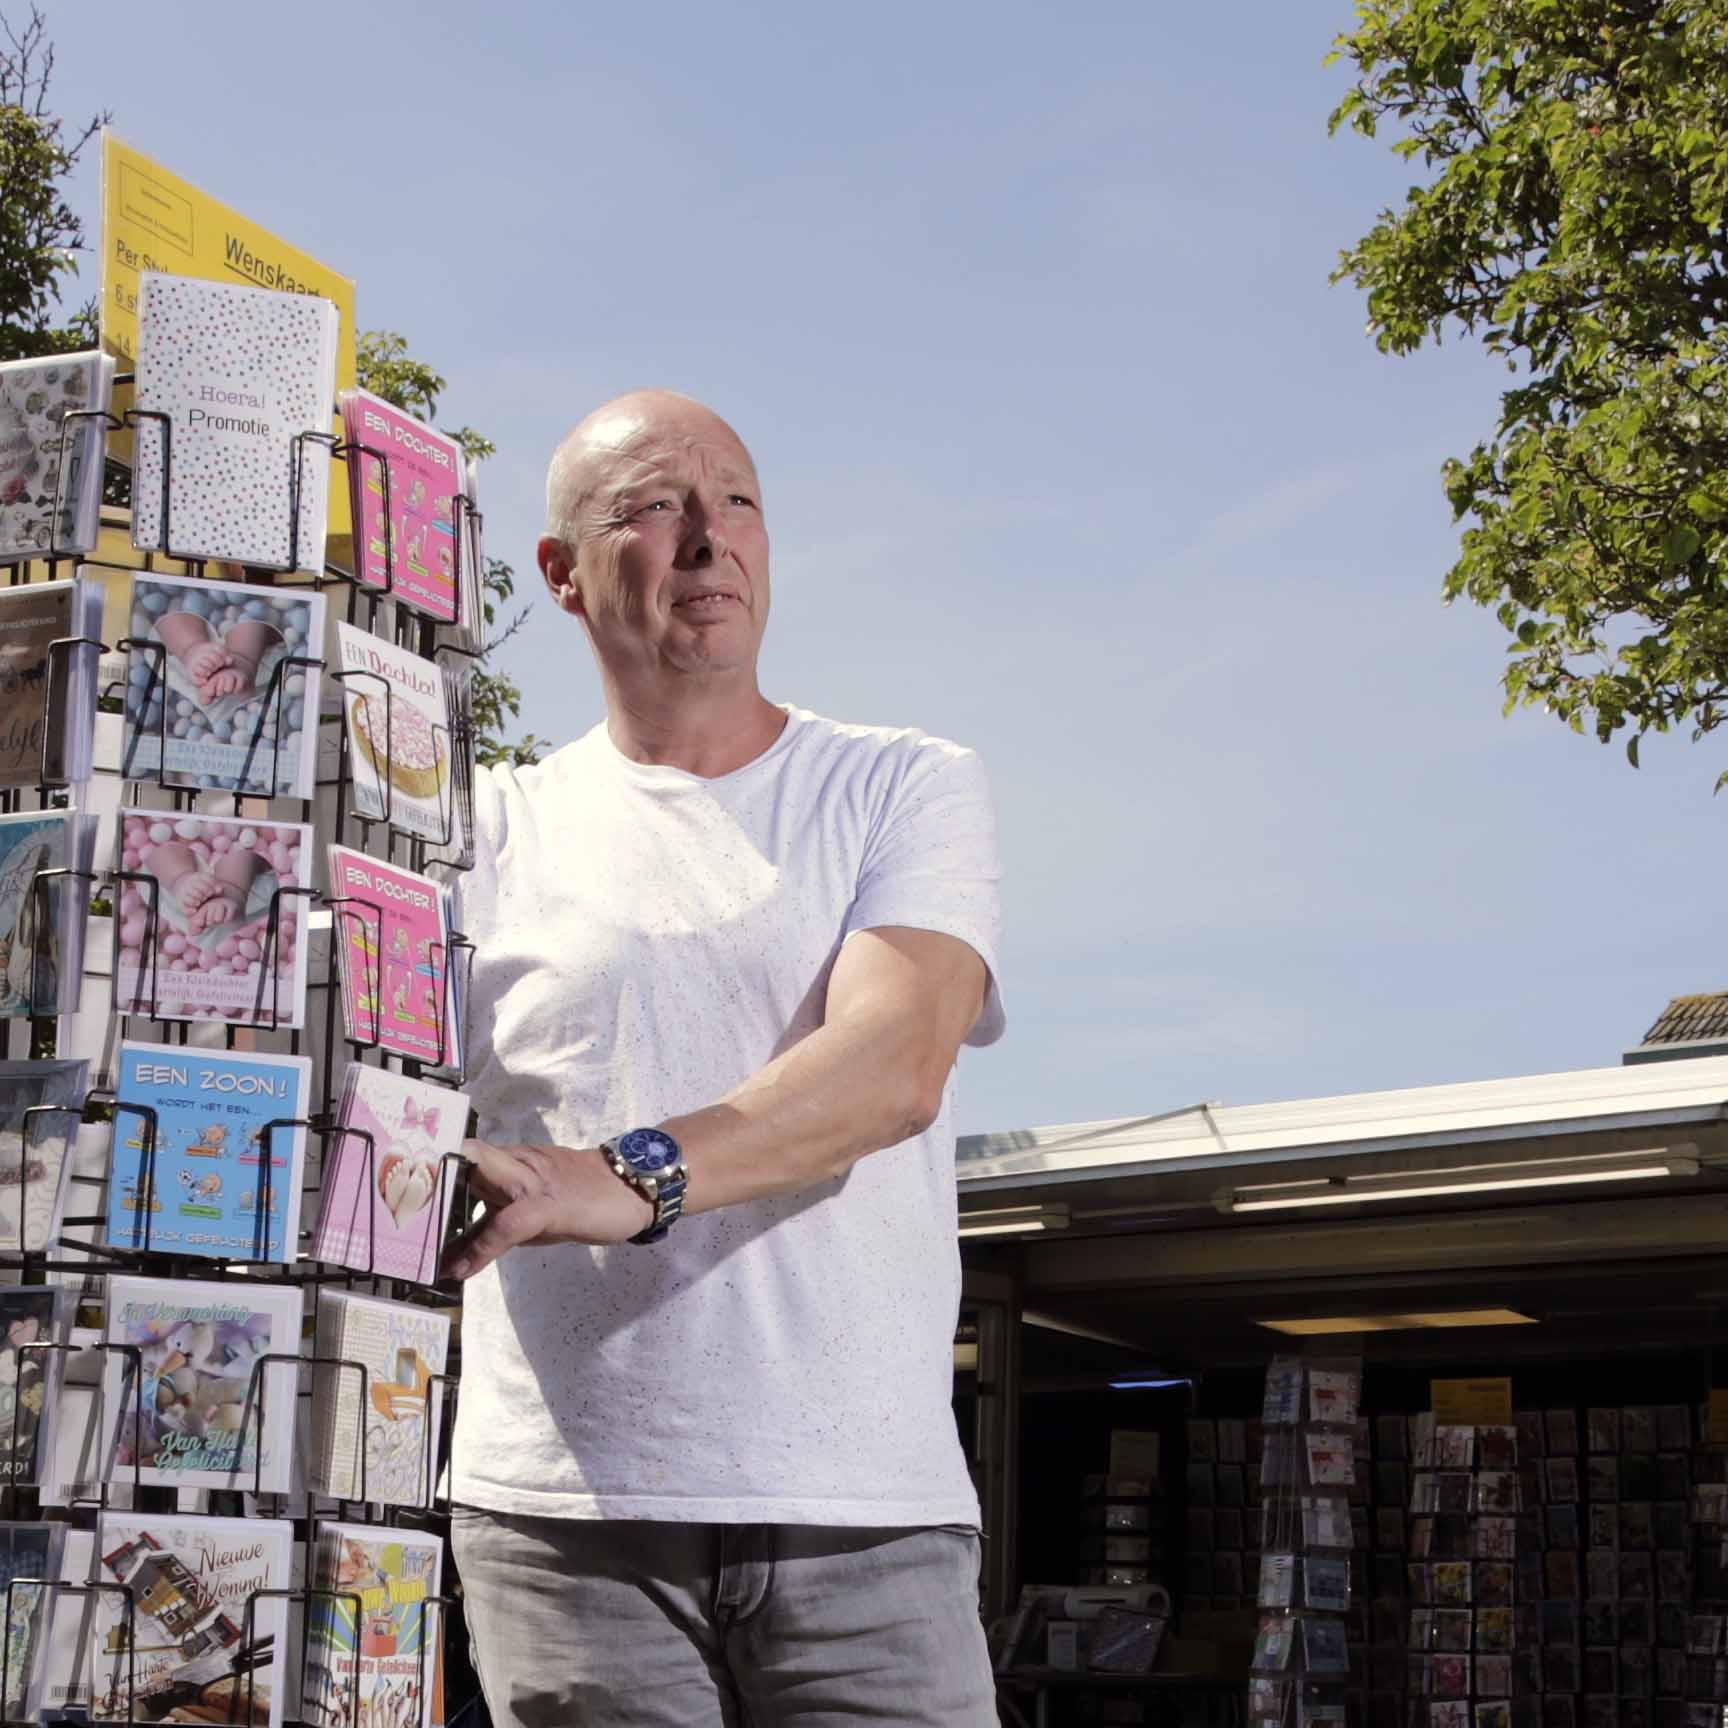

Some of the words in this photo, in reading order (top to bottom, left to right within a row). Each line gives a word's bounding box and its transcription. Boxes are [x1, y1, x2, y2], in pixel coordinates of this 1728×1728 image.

[116, 239, 138, 267] Per
[199, 385, 265, 409] Hoera!
[189, 408, 270, 437] Promotie
[364, 410, 391, 437] EEN
[345, 867, 373, 890] EEN
[135, 1063, 188, 1086] EEN
[199, 1070, 289, 1100] ZOON!
[156, 1098, 195, 1110] WORDT
[200, 1101, 222, 1112] HET
[160, 1431, 202, 1452] Van
[200, 1542, 264, 1576] Nieuwe
